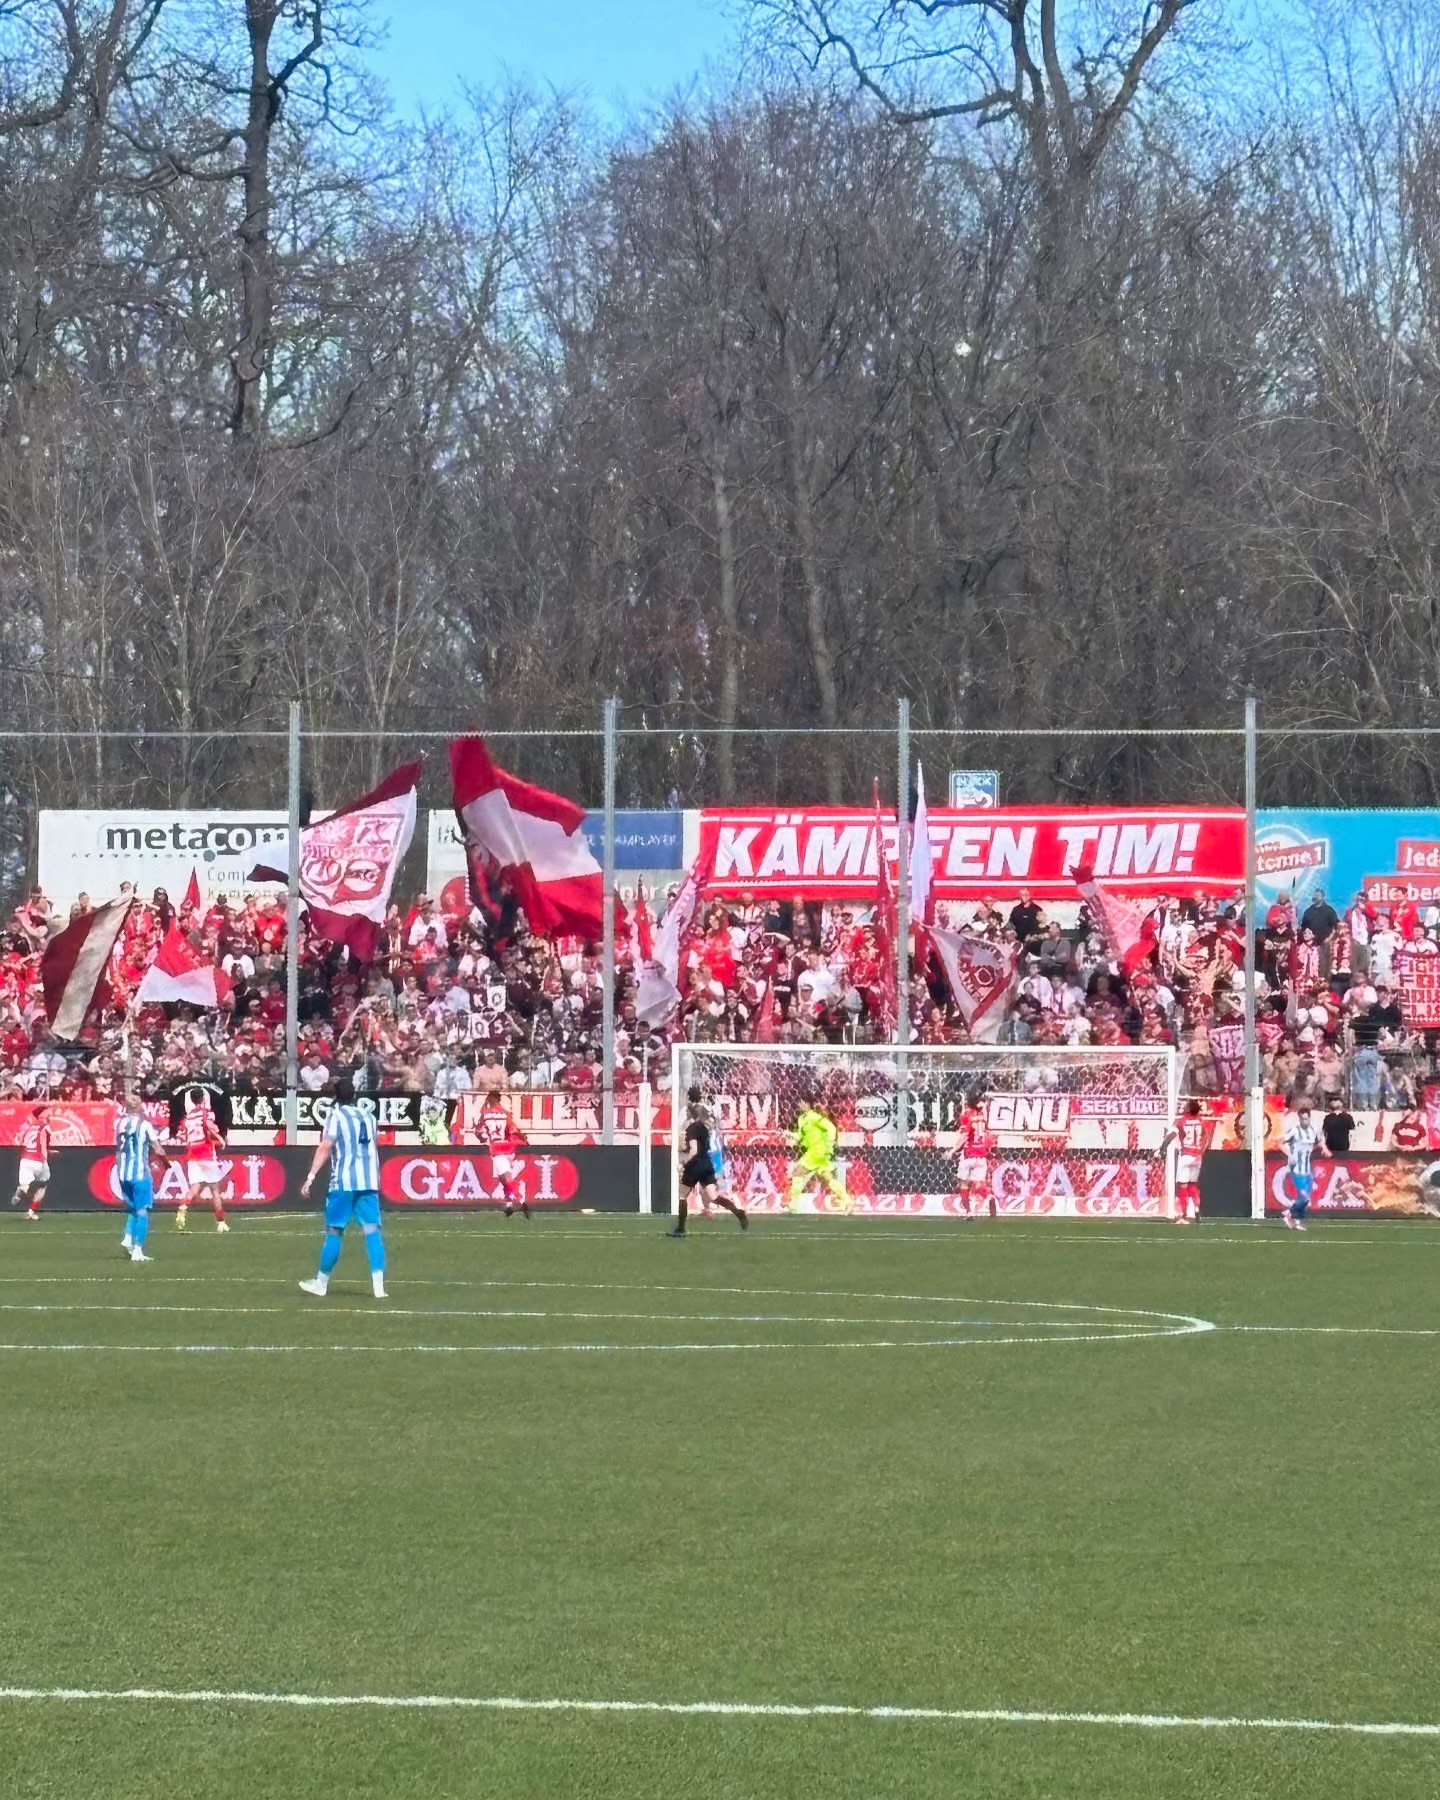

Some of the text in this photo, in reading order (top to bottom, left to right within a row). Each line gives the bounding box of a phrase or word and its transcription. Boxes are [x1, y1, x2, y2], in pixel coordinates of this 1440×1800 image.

[1057, 823, 1201, 877] TIM!
[1403, 846, 1440, 869] Jed
[229, 1096, 413, 1127] KATEGRIE
[989, 1096, 1071, 1131] GNU
[991, 1161, 1152, 1200] GAZI
